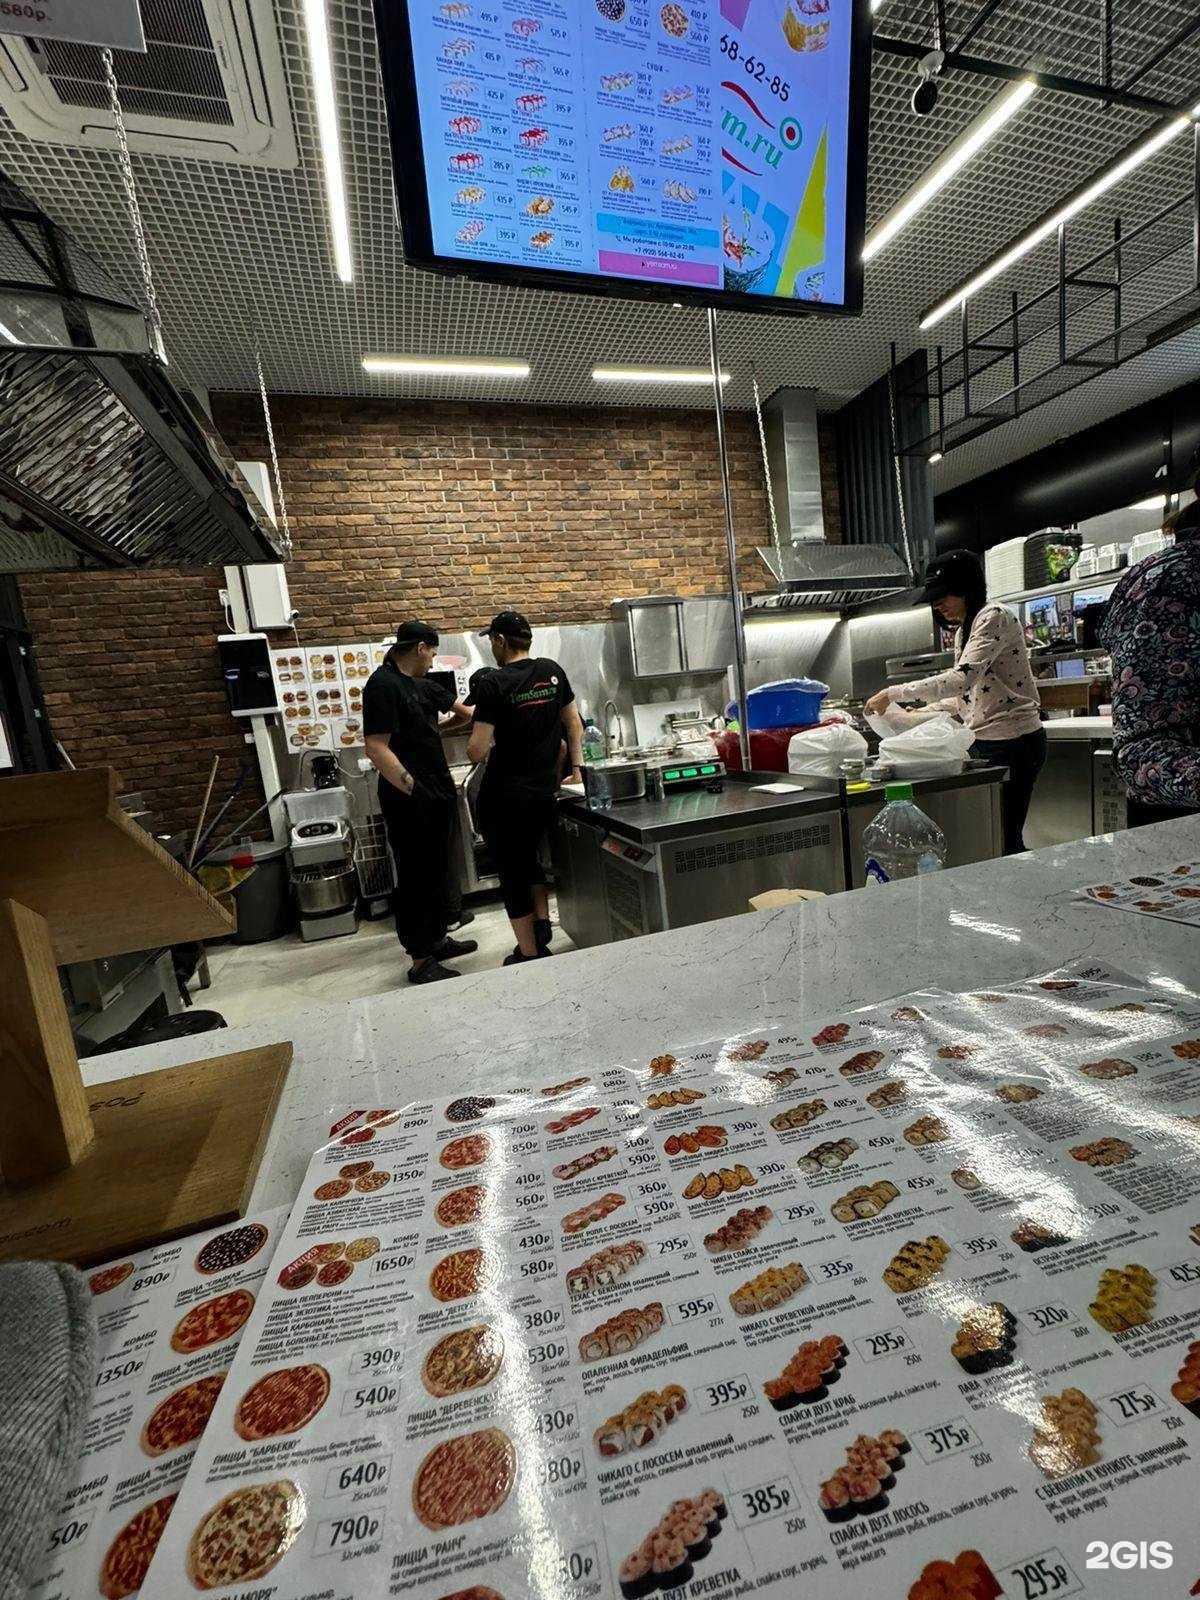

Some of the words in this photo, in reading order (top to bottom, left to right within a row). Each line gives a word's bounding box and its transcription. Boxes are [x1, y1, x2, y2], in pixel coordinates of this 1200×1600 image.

[785, 1205, 815, 1220] 295₽
[393, 1233, 419, 1244] КОМБО
[962, 1237, 998, 1255] 395₽
[287, 1248, 320, 1273] АКЦИЯ
[820, 1260, 853, 1279] 335₽
[678, 1299, 714, 1320] 595₽
[739, 1320, 768, 1333] ЧИКАГО
[775, 1302, 816, 1321] КРЕВЕТКОЙ
[1028, 1306, 1070, 1328] 320₽
[866, 1333, 905, 1355] 295₽
[581, 1361, 629, 1381] ОПАЛЕННАЯ
[629, 1343, 690, 1367] ФИЛАДЕЛЬФИЯ
[706, 1380, 747, 1407] 395₽
[958, 1381, 981, 1395] ЛАВА
[778, 1408, 813, 1427] СПАЙСИ
[814, 1402, 834, 1417] ДУЭТ
[835, 1394, 856, 1409] КРАБ
[1110, 1391, 1158, 1419] 275₽
[925, 1424, 970, 1454] 375₽
[212, 1450, 246, 1466] ПИЦЦА
[597, 1463, 633, 1484] ЧИКАГО
[642, 1449, 684, 1471] ЛОСОСЕМ
[339, 1462, 387, 1490] 640₽
[742, 1485, 790, 1518] 385₽
[330, 1515, 379, 1548] 790₽
[829, 1522, 868, 1546] СПАЙСИ
[868, 1513, 892, 1533] ДУЭТ
[892, 1501, 930, 1523] ЛОСОСЬ
[392, 1548, 428, 1569] ПИЦЦА
[1011, 1558, 1068, 1600] 295₽
